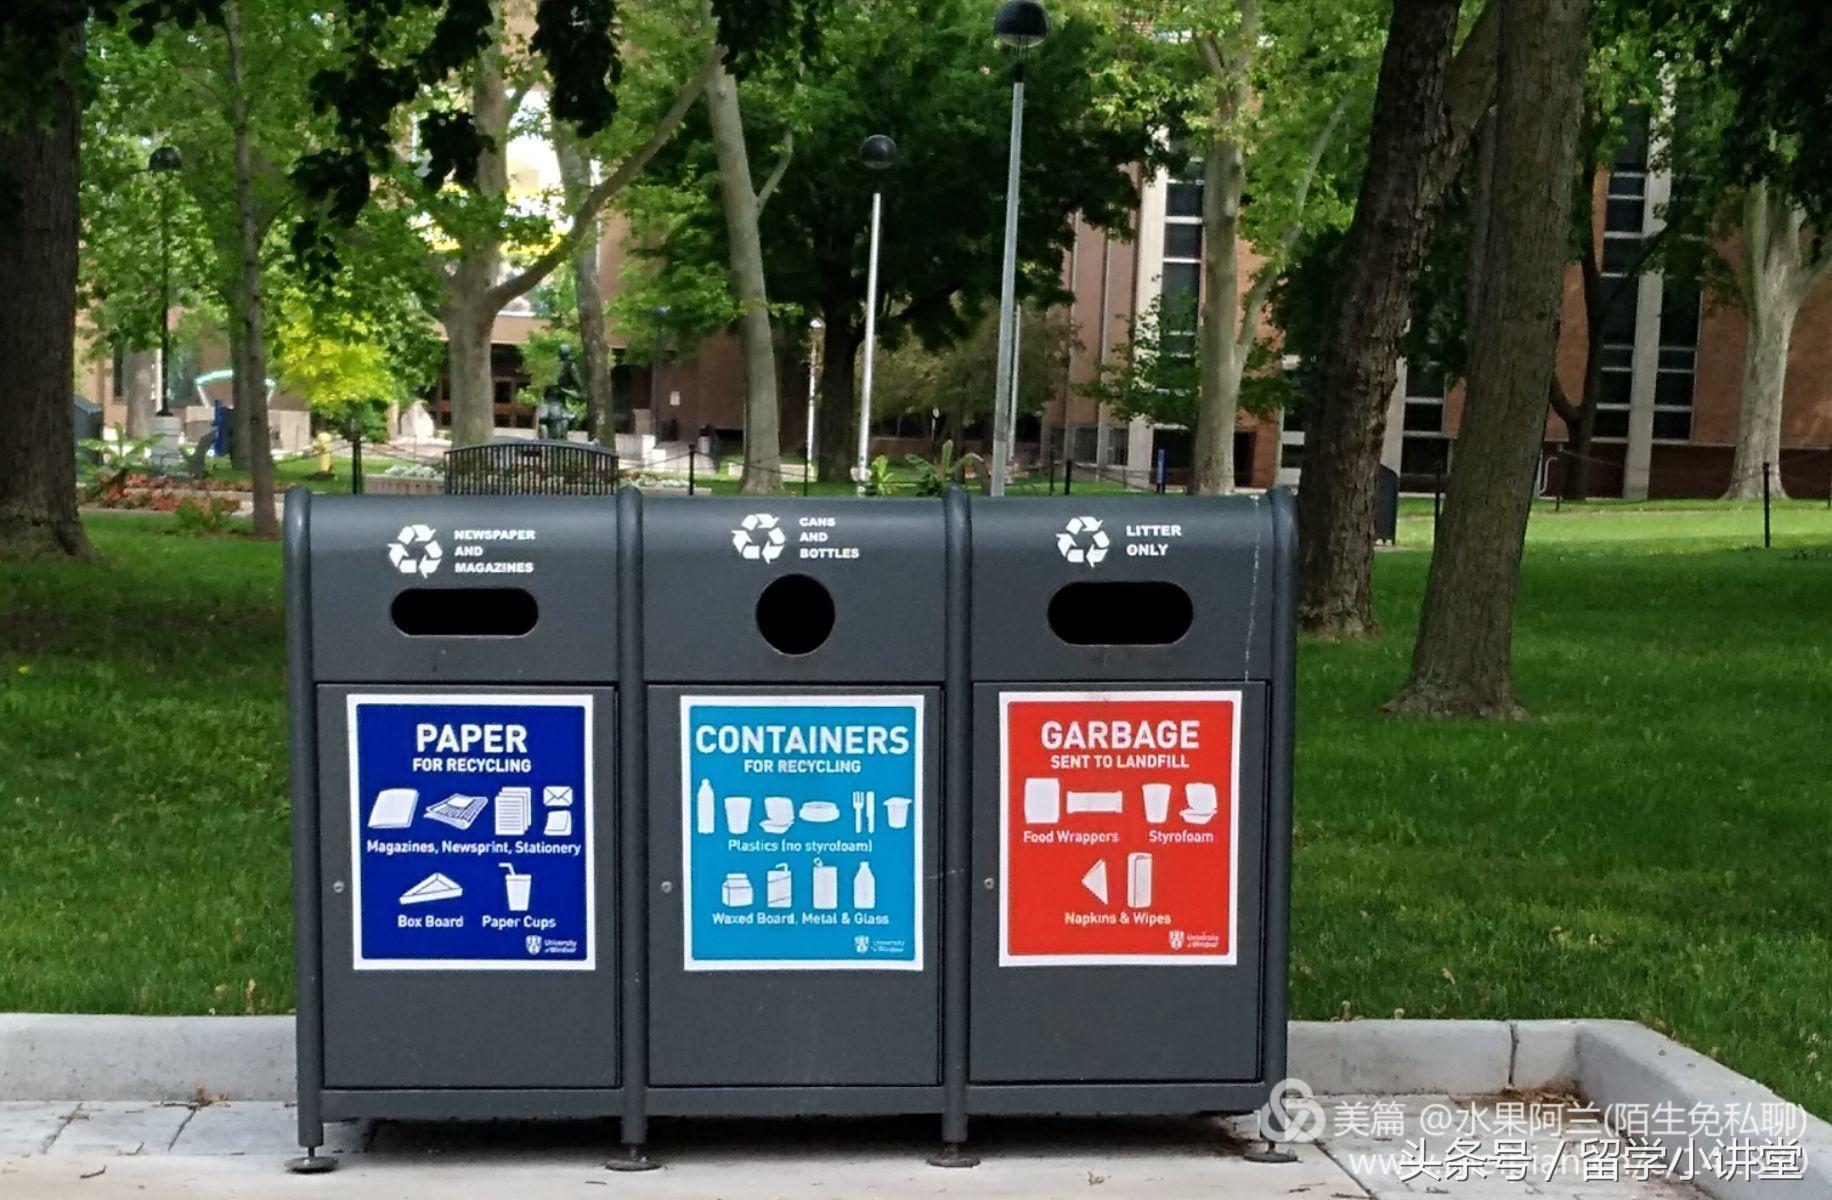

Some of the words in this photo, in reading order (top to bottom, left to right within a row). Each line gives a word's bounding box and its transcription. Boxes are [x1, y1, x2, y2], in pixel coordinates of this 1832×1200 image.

[799, 517, 836, 527] CANS
[454, 530, 536, 540] NEWSPAPER
[799, 532, 829, 542] AND
[1126, 525, 1182, 537] LITTER
[454, 546, 483, 556] AND
[799, 548, 860, 559] BOTTLES
[1126, 543, 1169, 556] ONLY
[454, 562, 534, 573] MAGAZINES
[416, 723, 528, 753] PAPER
[695, 725, 910, 754] CONTAINERS
[1041, 720, 1200, 749] GARBAGE
[412, 758, 443, 772] FOR
[446, 758, 532, 772] RECYCLING
[743, 759, 774, 773] FOR
[777, 759, 861, 773] RECYCLING
[1050, 755, 1091, 768] SENT
[1094, 755, 1112, 768] TO
[1116, 754, 1190, 768] LANDFILL
[1023, 831, 1054, 843] Food
[1056, 831, 1120, 845] Wrappers
[1149, 830, 1214, 844] Styrofoam
[366, 840, 439, 855] Magazines,
[442, 840, 512, 856] Newsprint,
[515, 841, 582, 856] Stationery
[728, 839, 778, 851] Plastics
[781, 839, 802, 852] (no
[805, 839, 873, 854] styrofoam)
[397, 915, 422, 927] Box
[425, 914, 464, 927] Board
[482, 915, 520, 930] Paper
[523, 915, 556, 930] Cups
[712, 912, 753, 924] Waxed
[757, 912, 797, 926] Board,
[802, 912, 837, 924] Metal
[841, 912, 851, 924] &
[854, 912, 890, 924] Glass
[1064, 912, 1117, 927] Napkins
[1119, 912, 1130, 924] &
[1132, 912, 1172, 926] Wipes
